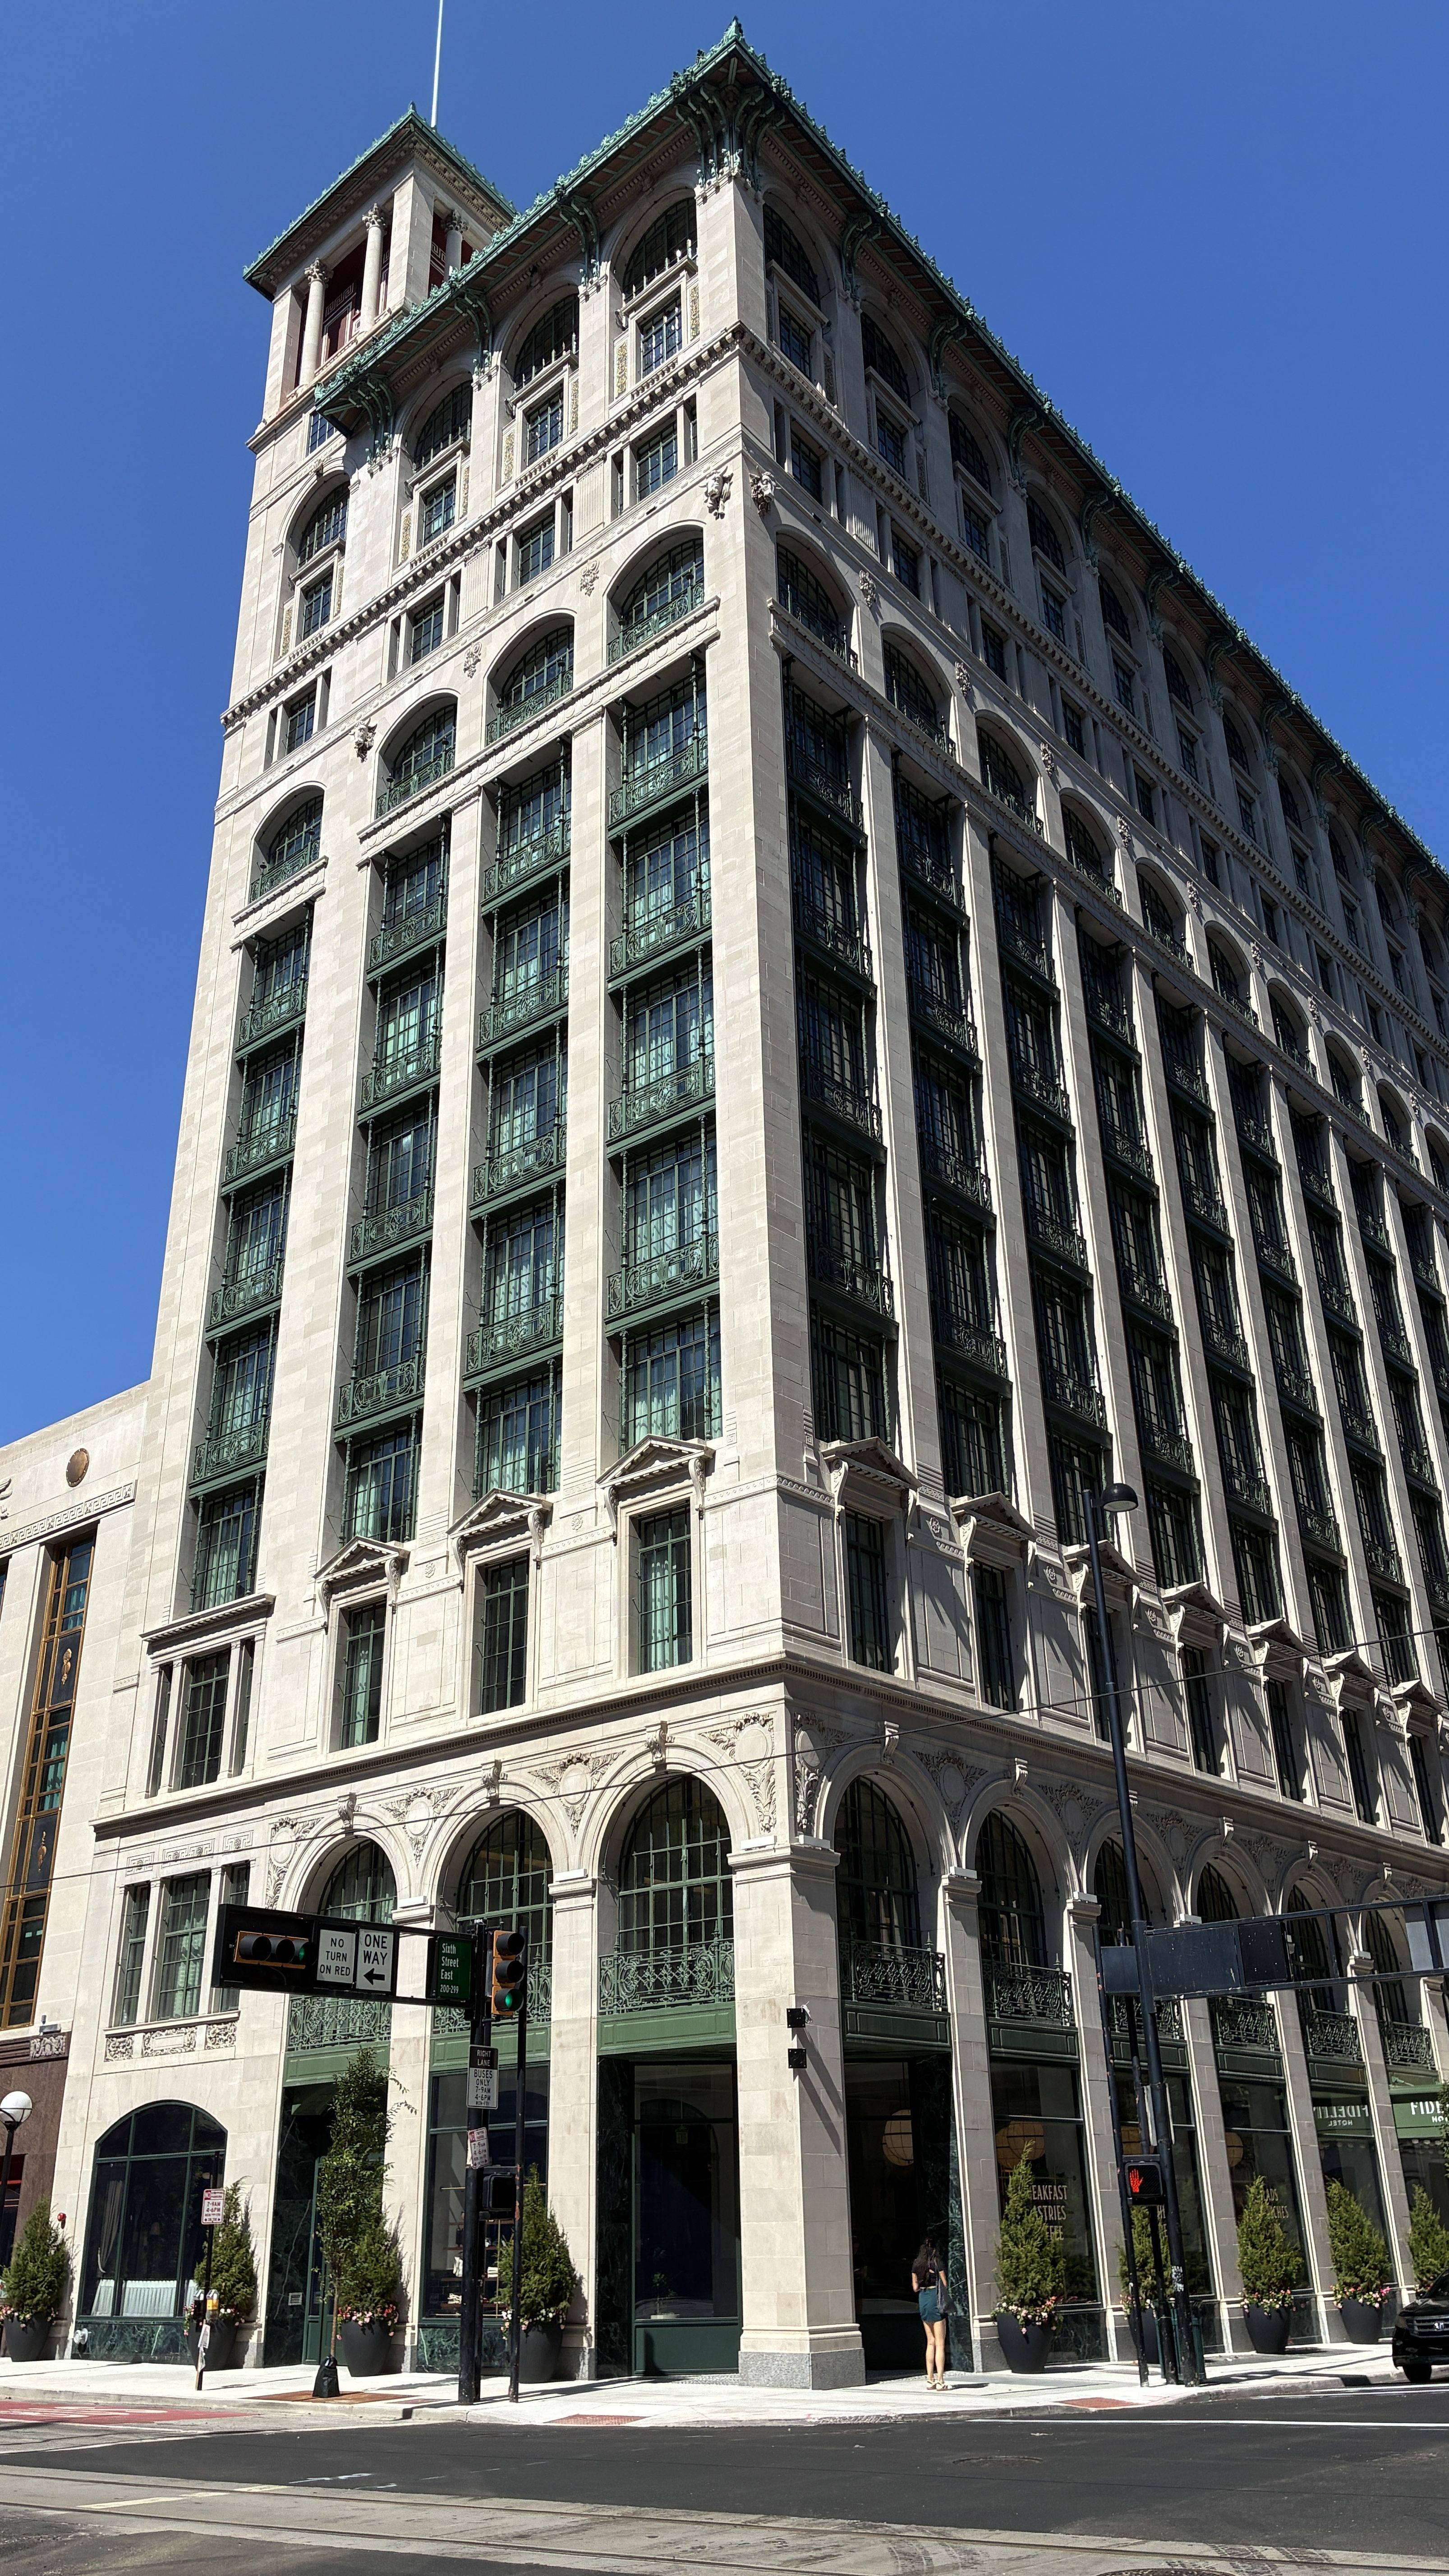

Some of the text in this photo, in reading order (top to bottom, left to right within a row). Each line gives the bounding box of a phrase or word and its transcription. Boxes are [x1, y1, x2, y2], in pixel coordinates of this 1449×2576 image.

[331, 1937, 344, 1948] NO
[364, 1934, 387, 1949] ONE
[442, 1943, 456, 1954] Sixth
[326, 1950, 347, 1962] TURN
[363, 1950, 387, 1965] WAY
[442, 1956, 459, 1968] Street
[320, 1964, 350, 1976] ON RED
[441, 1969, 453, 1980] East
[440, 1984, 459, 1994] 200-299
[477, 2049, 491, 2057] RIGHT
[477, 2058, 490, 2066] LANE
[474, 2069, 492, 2079] BUSES
[476, 2078, 490, 2086] ONLY
[1031, 2185, 1067, 2200] EAKFAST
[1036, 2205, 1067, 2221] STRIES
